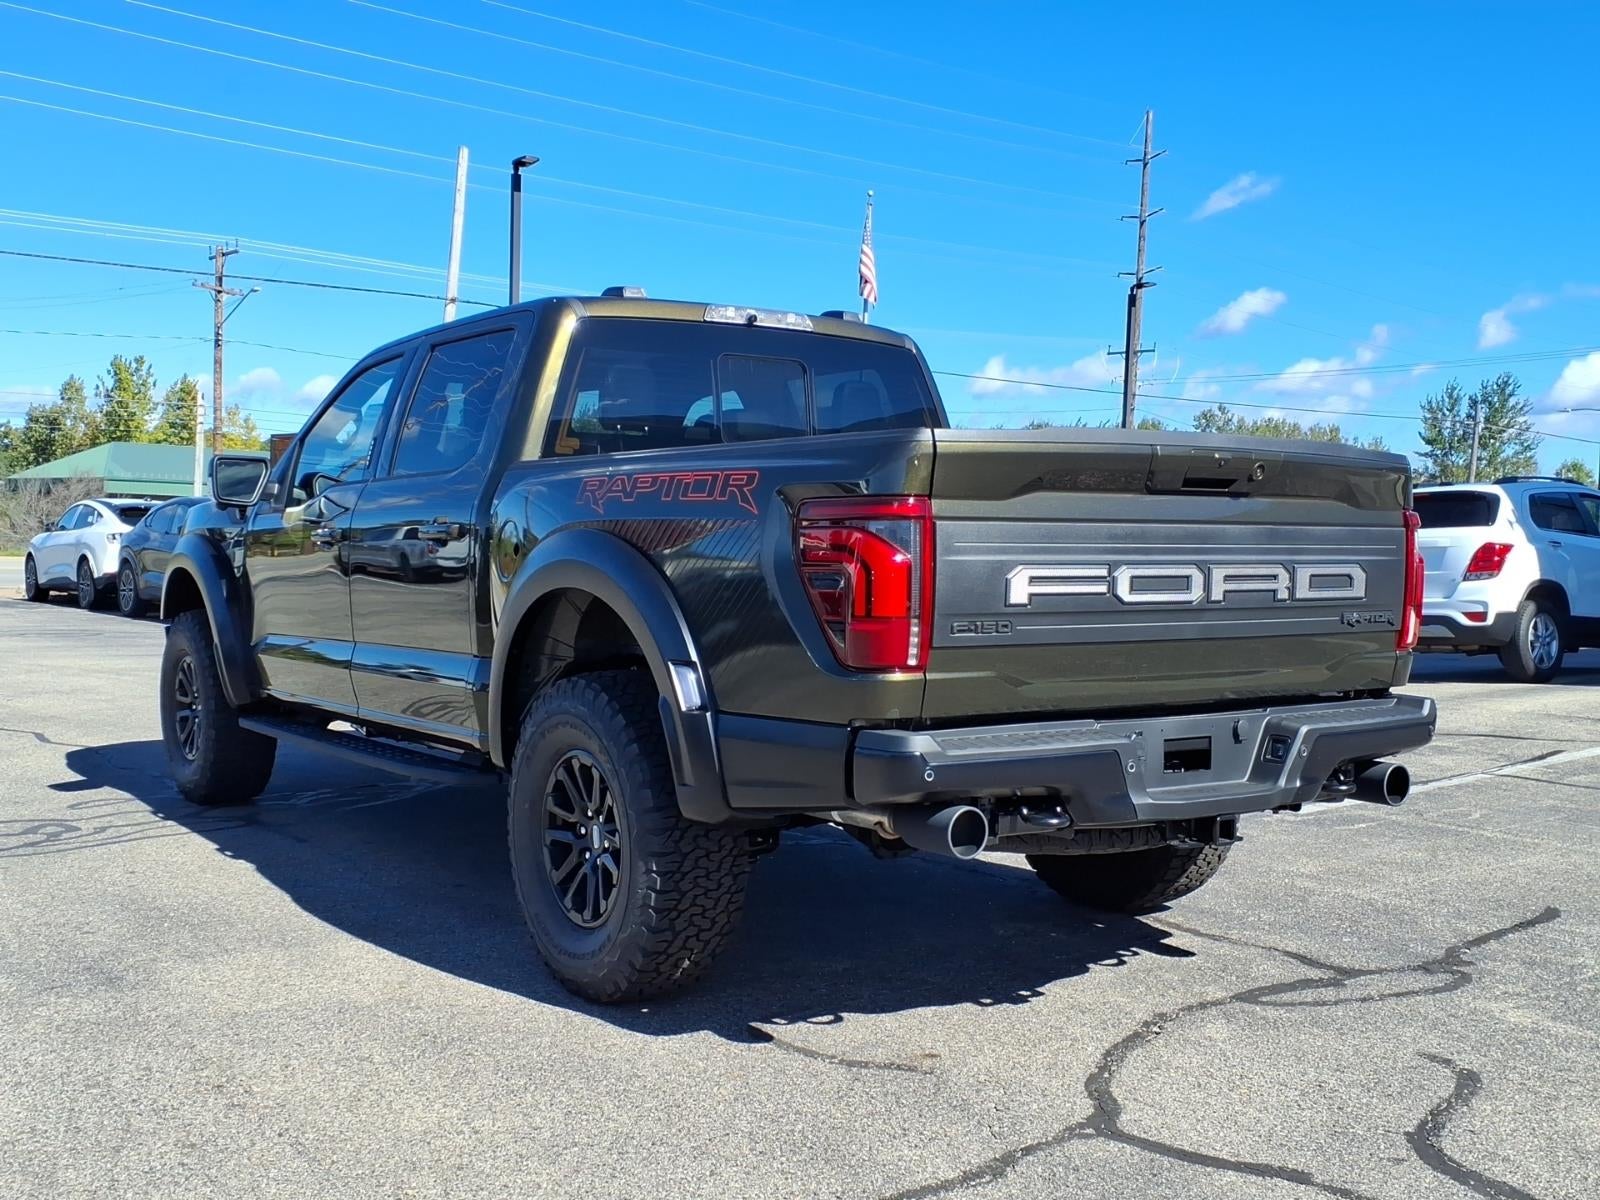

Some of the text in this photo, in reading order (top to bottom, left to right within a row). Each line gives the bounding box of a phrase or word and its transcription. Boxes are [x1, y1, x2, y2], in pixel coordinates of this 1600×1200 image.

[576, 471, 759, 514] RAPTOR
[1005, 564, 1368, 607] FORD
[1341, 610, 1395, 627] RAPTOR
